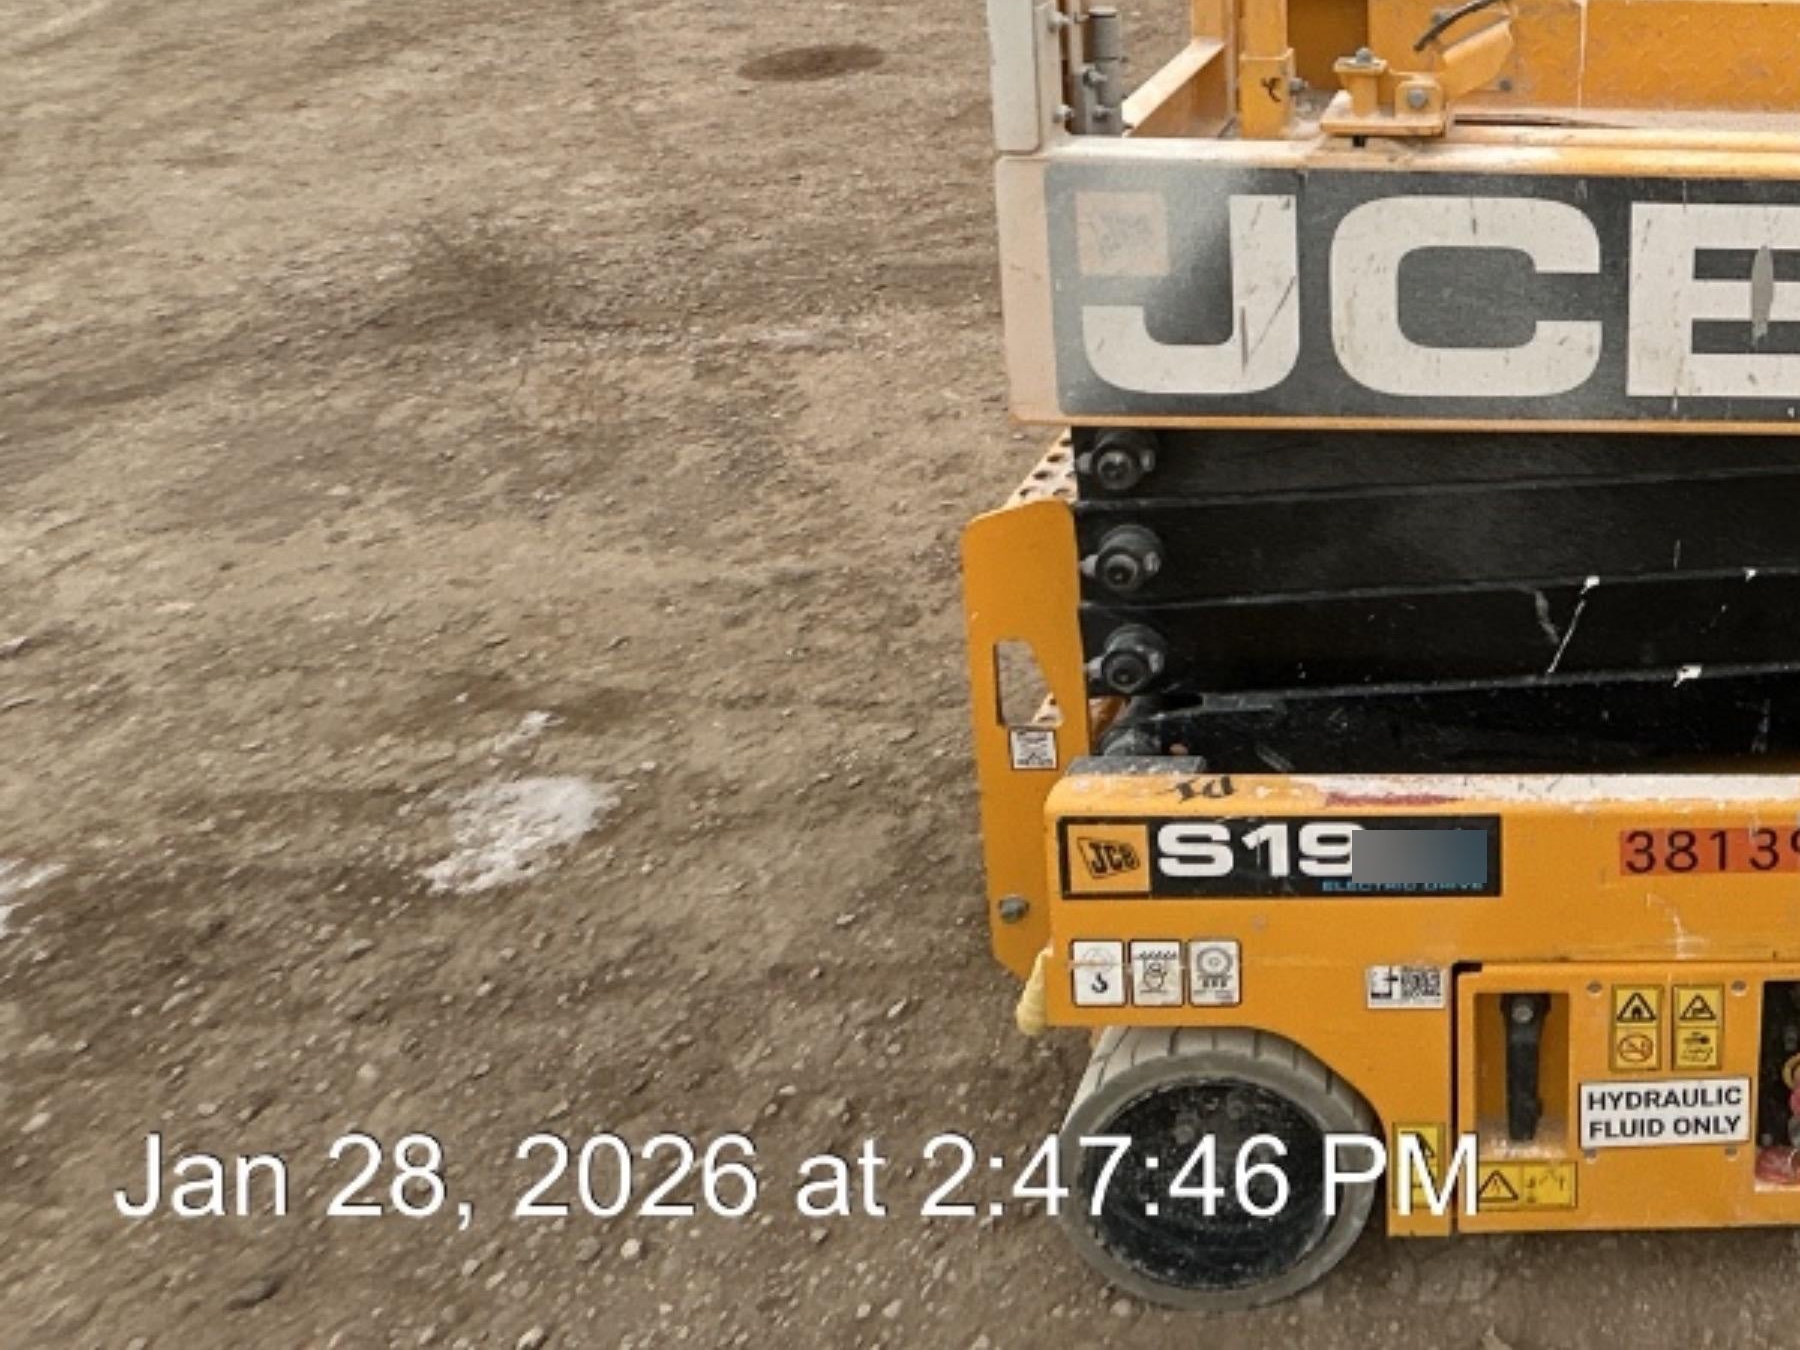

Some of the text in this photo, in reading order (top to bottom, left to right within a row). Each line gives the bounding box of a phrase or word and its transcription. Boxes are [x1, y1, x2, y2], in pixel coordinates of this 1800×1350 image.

[1088, 841, 1141, 874] JCB
[1587, 1086, 1742, 1111] HYDRAULIC
[1589, 1115, 1741, 1139] FLUID ONLY
